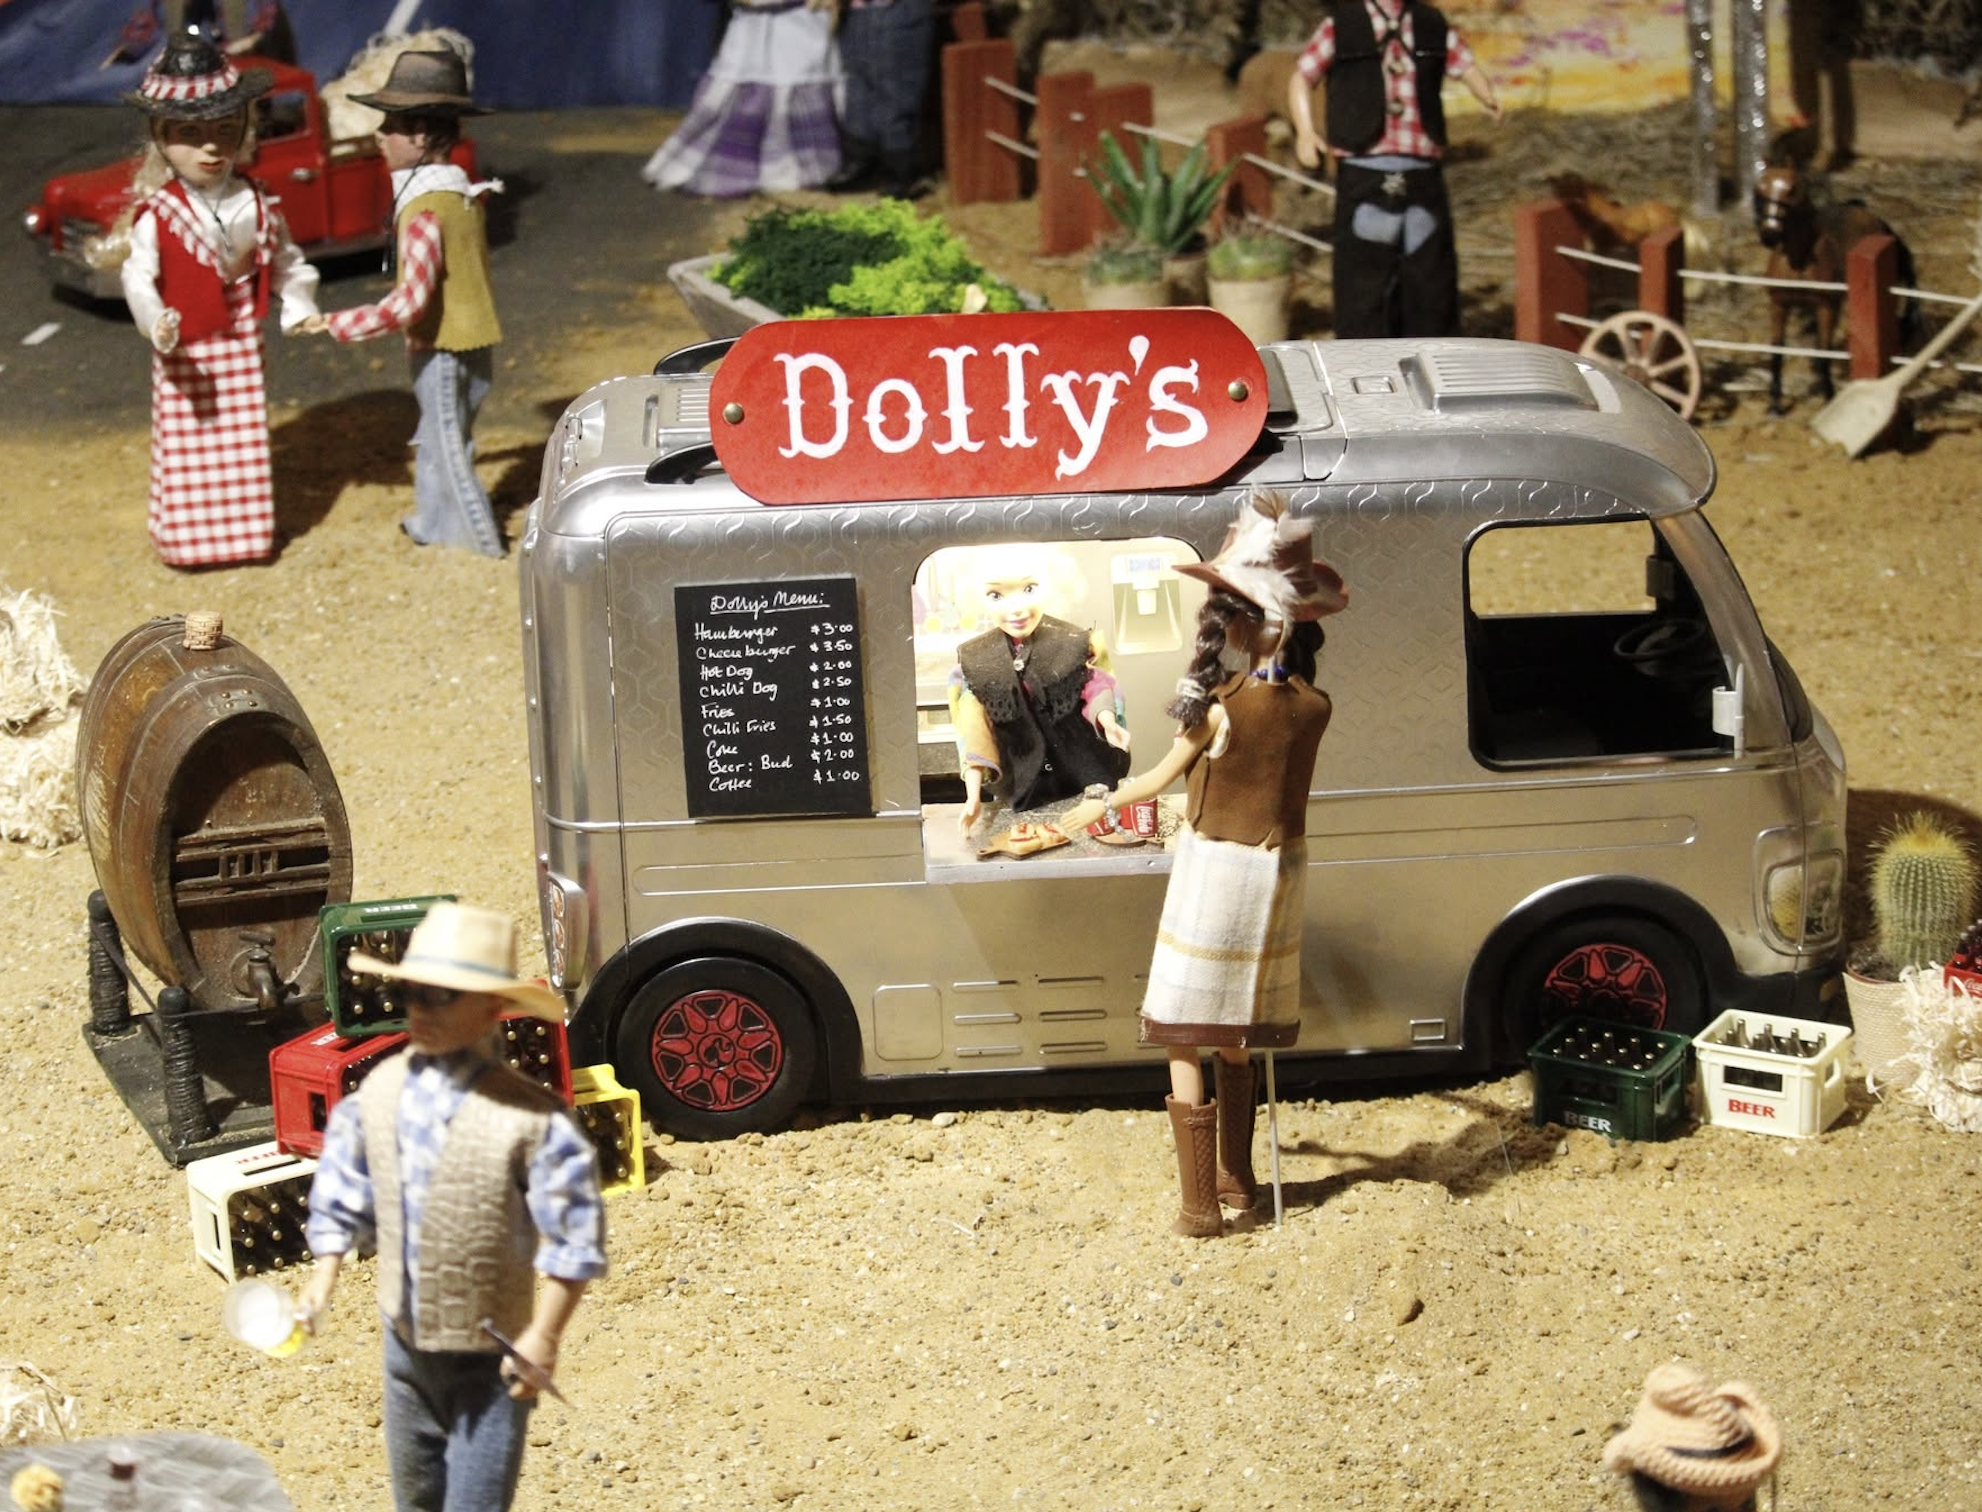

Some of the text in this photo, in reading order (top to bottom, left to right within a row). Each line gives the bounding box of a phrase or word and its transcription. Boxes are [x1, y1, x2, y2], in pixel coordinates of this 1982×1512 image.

[773, 335, 1209, 481] Dolly's
[710, 590, 825, 620] Dolly's Menu:
[694, 622, 778, 645] Hamburger
[700, 664, 723, 681] Hot
[726, 665, 753, 681] Dog
[700, 682, 744, 698] Chilli
[753, 681, 778, 702] Dog
[701, 701, 735, 719] Fries
[703, 722, 740, 737] Chilli
[747, 719, 776, 733] Fries
[761, 754, 793, 770] Bud
[709, 777, 752, 792] Coffee
[1728, 1098, 1776, 1119] BEER
[1564, 1111, 1612, 1133] BEER
